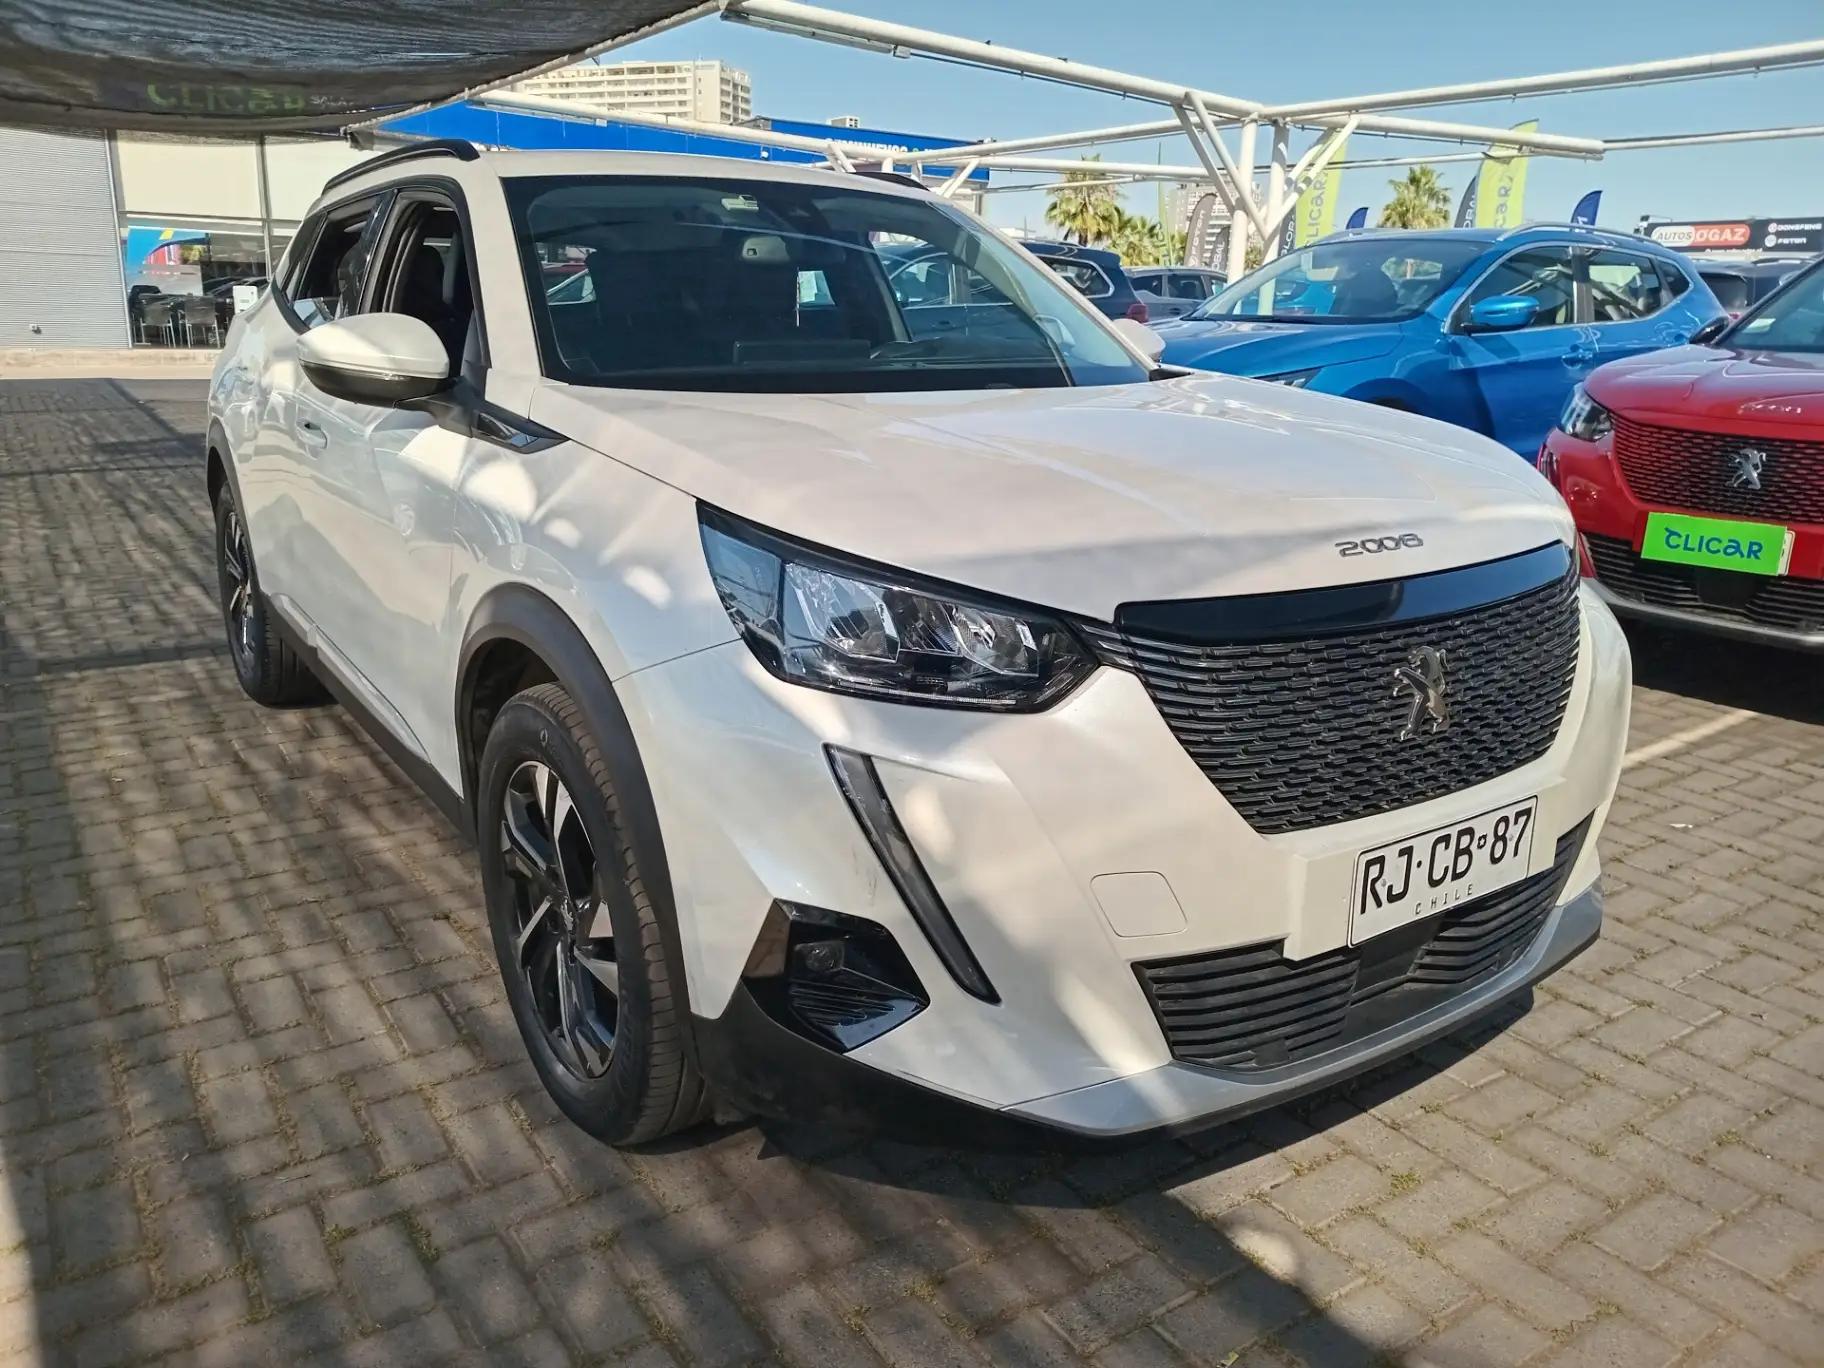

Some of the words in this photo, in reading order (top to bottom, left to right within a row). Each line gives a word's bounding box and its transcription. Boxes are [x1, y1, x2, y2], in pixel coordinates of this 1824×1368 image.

[1656, 231, 1693, 241] AUTOS
[1694, 228, 1746, 242] OGAZ
[1335, 533, 1423, 557] 2008
[1415, 883, 1473, 915] CHILE
